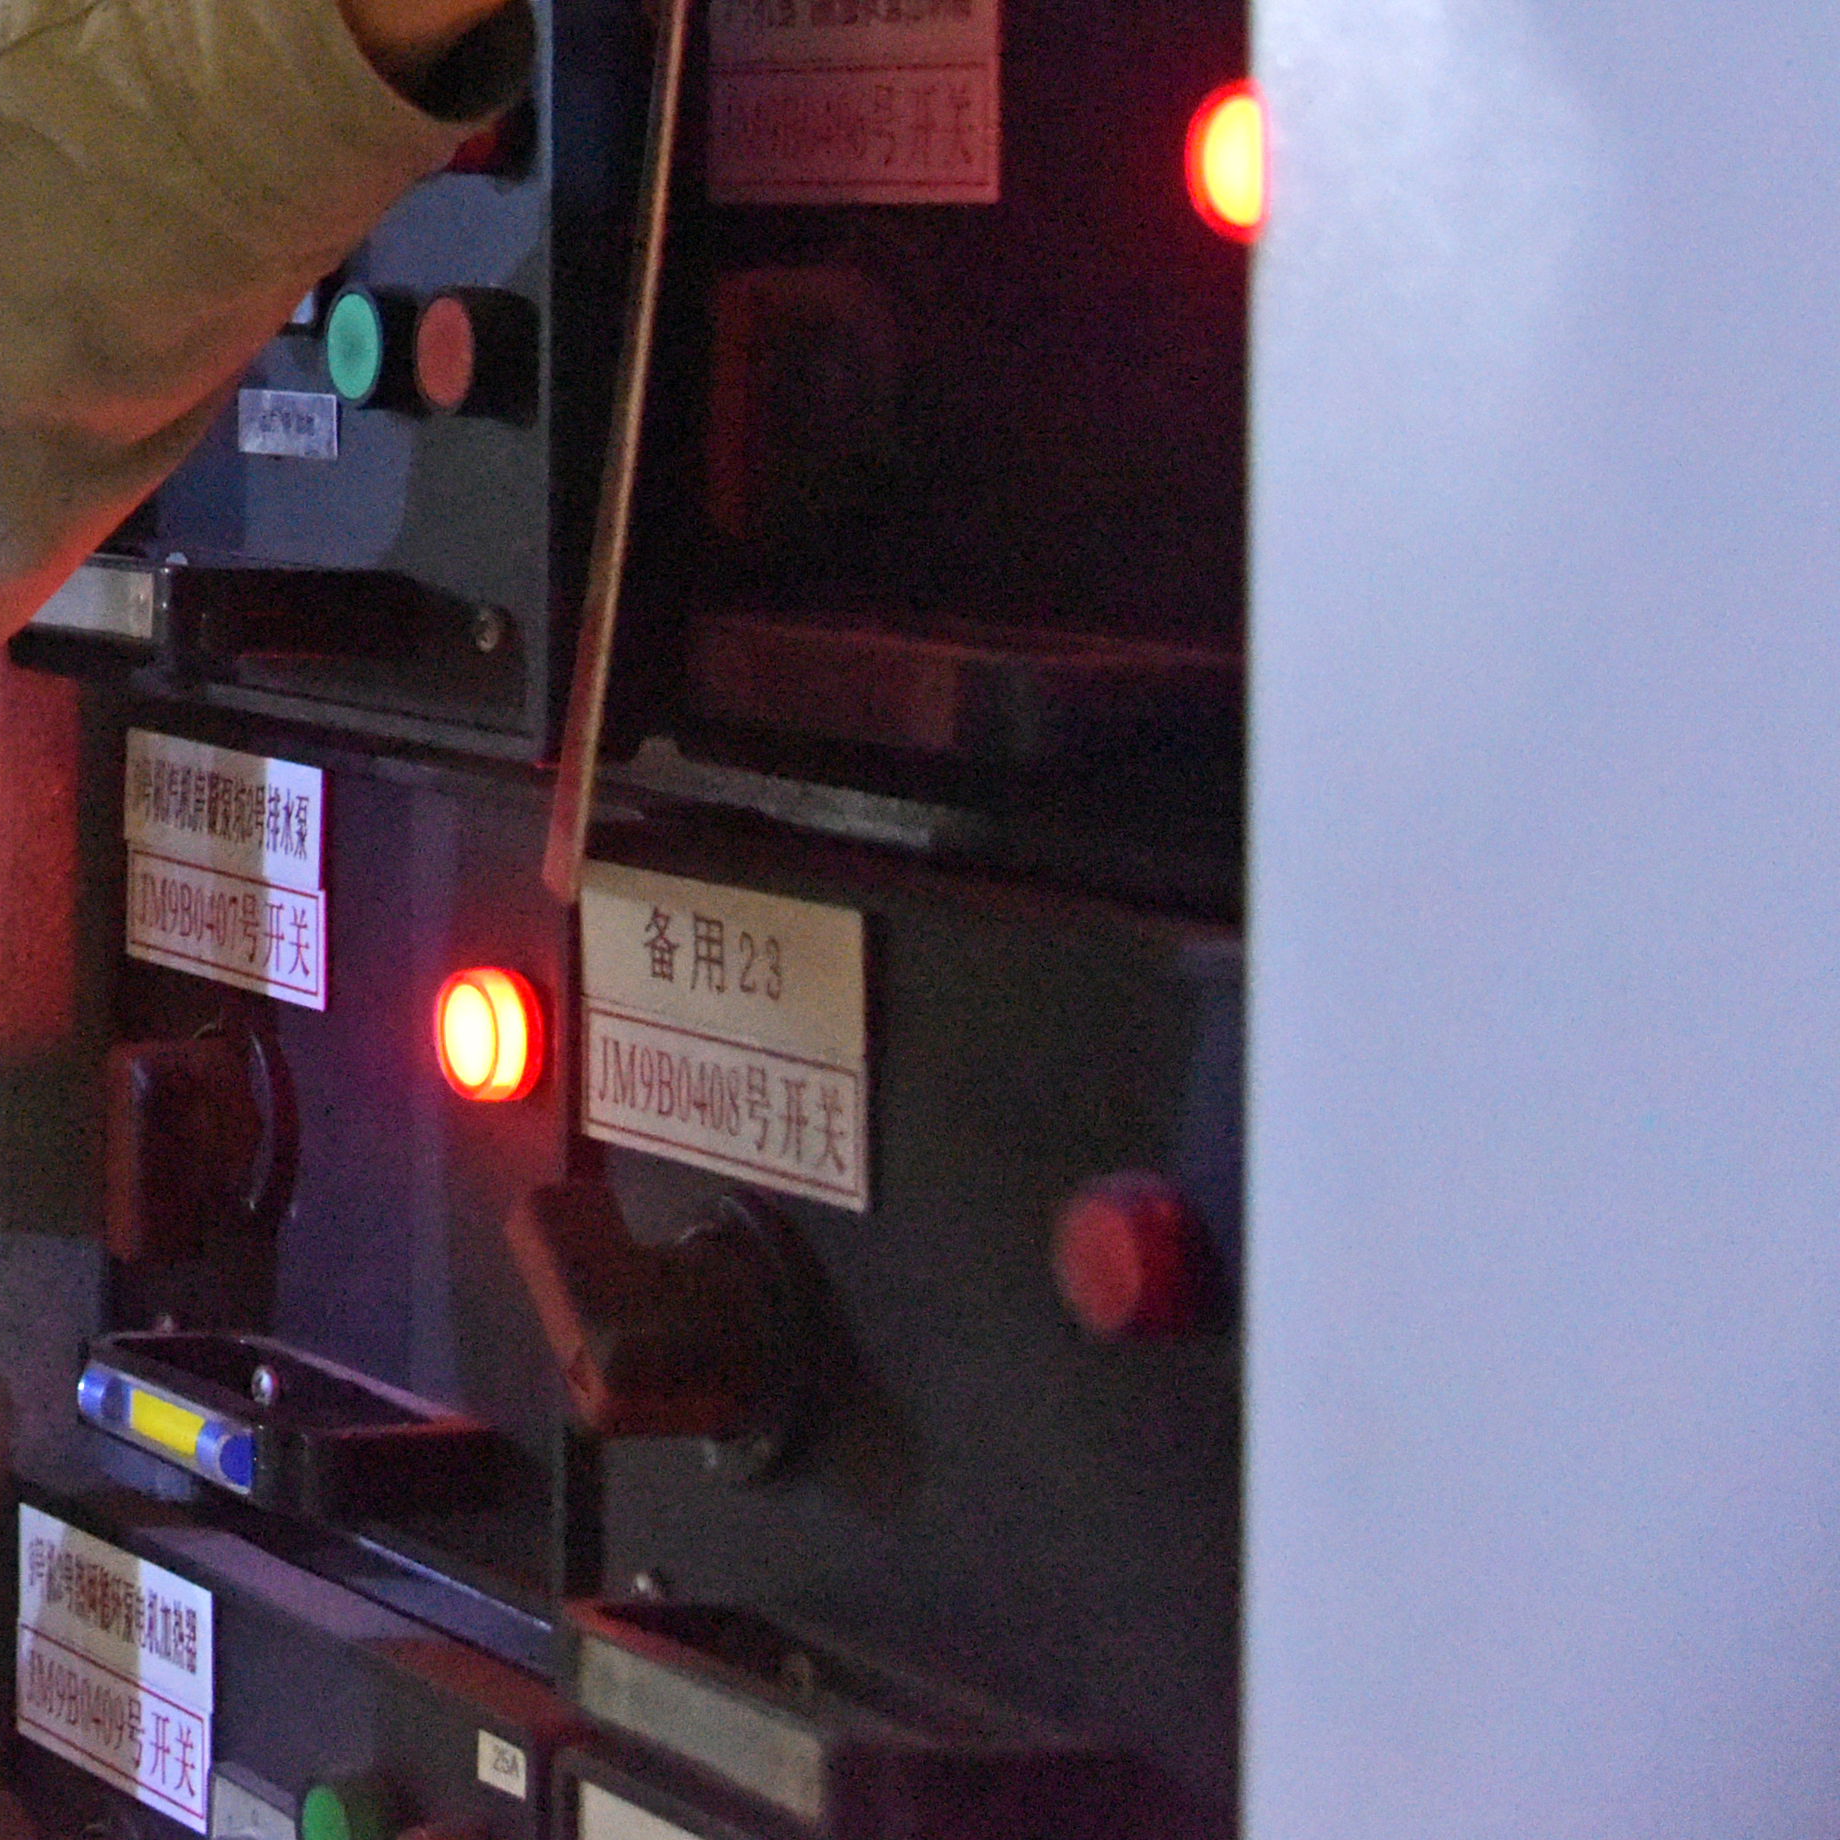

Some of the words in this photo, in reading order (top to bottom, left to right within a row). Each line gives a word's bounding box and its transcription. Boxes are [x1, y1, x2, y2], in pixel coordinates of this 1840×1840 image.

[643, 905, 783, 1001] 备用23
[597, 1036, 848, 1176] JM9B0408号开关
